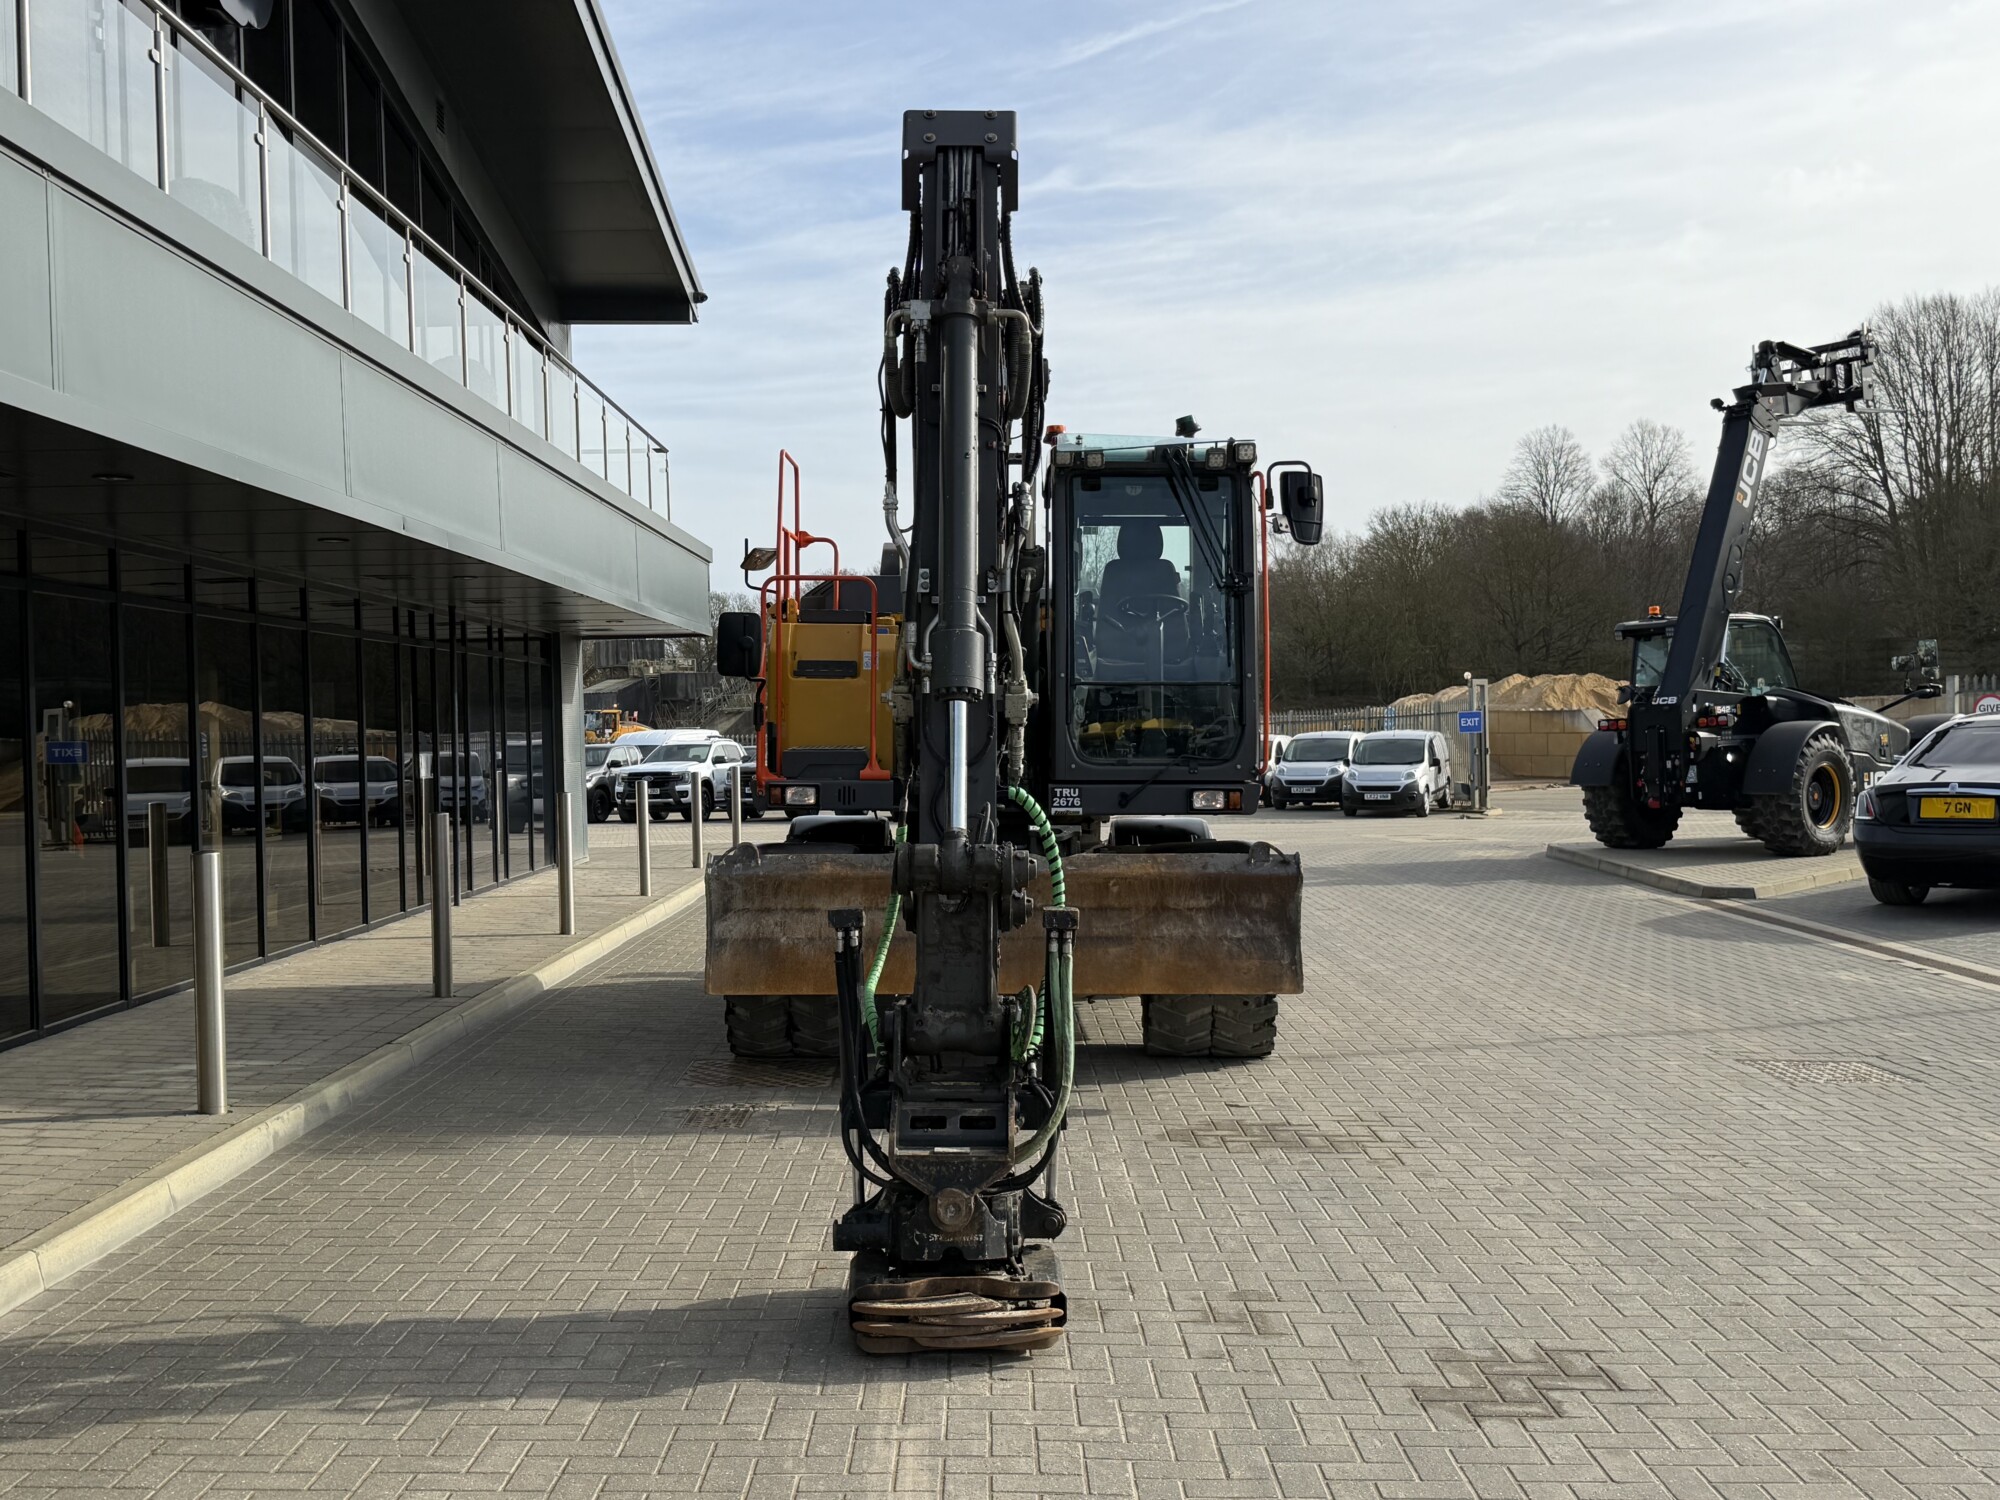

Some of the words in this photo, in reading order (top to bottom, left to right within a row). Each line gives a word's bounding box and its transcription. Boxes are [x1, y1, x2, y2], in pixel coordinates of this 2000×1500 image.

[1739, 429, 1764, 508] JCB
[1652, 696, 1677, 705] JCB
[1716, 705, 1731, 714] 542
[1979, 704, 2000, 712] GIVE
[1461, 718, 1479, 726] EXIT
[1054, 788, 1079, 797] TRU
[1053, 798, 1081, 806] 2676
[1944, 802, 1952, 813] 7
[1955, 802, 1971, 813] GN
